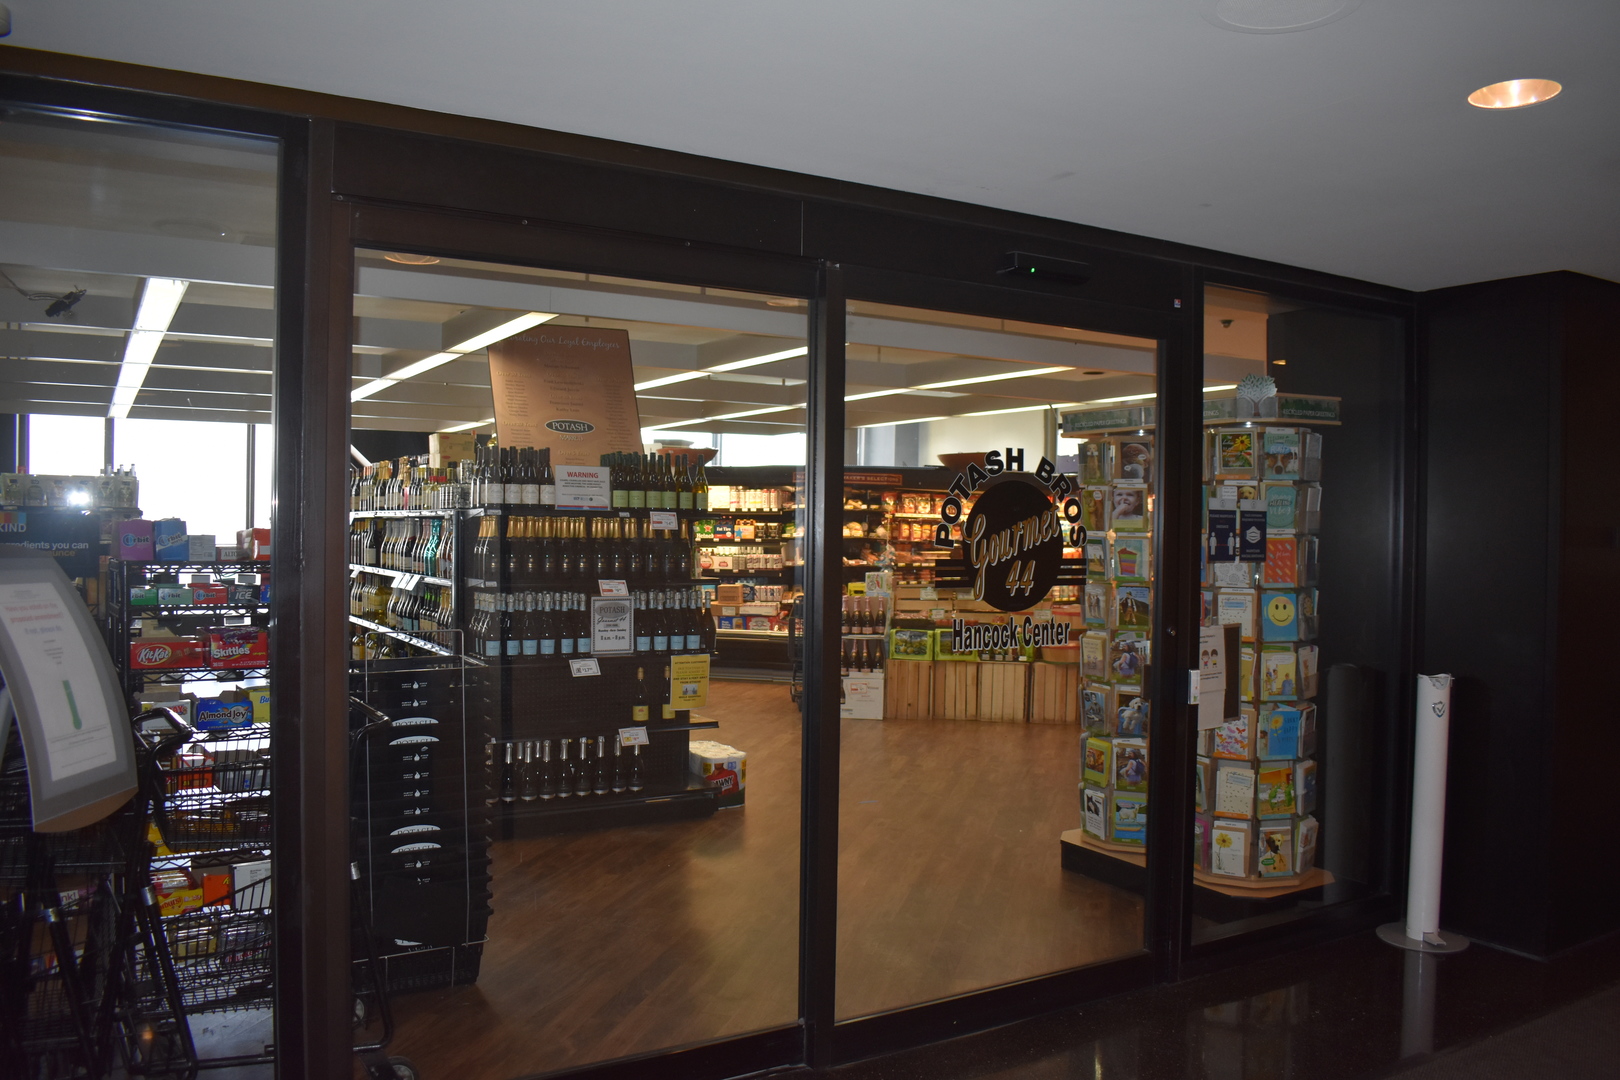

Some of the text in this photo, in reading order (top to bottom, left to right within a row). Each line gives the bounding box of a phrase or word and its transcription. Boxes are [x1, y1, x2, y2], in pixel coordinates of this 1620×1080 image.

[540, 335, 556, 344] Our
[558, 337, 579, 348] Loyal
[581, 338, 620, 350] Employees
[552, 421, 588, 431] POTASH
[567, 471, 599, 479] WARNING
[934, 447, 1087, 549] POTASH BROS
[0, 523, 27, 532] KIND
[51, 542, 70, 550] you
[122, 533, 150, 547] Orbit
[960, 503, 1060, 602] Gourmet
[1005, 559, 1036, 597] 44
[132, 590, 145, 599] rbit
[235, 591, 252, 599] ICE
[599, 606, 625, 614] POTASH
[952, 614, 1070, 652] Hancock Center
[213, 646, 250, 659] Skittles
[198, 709, 247, 722] Almond Joy
